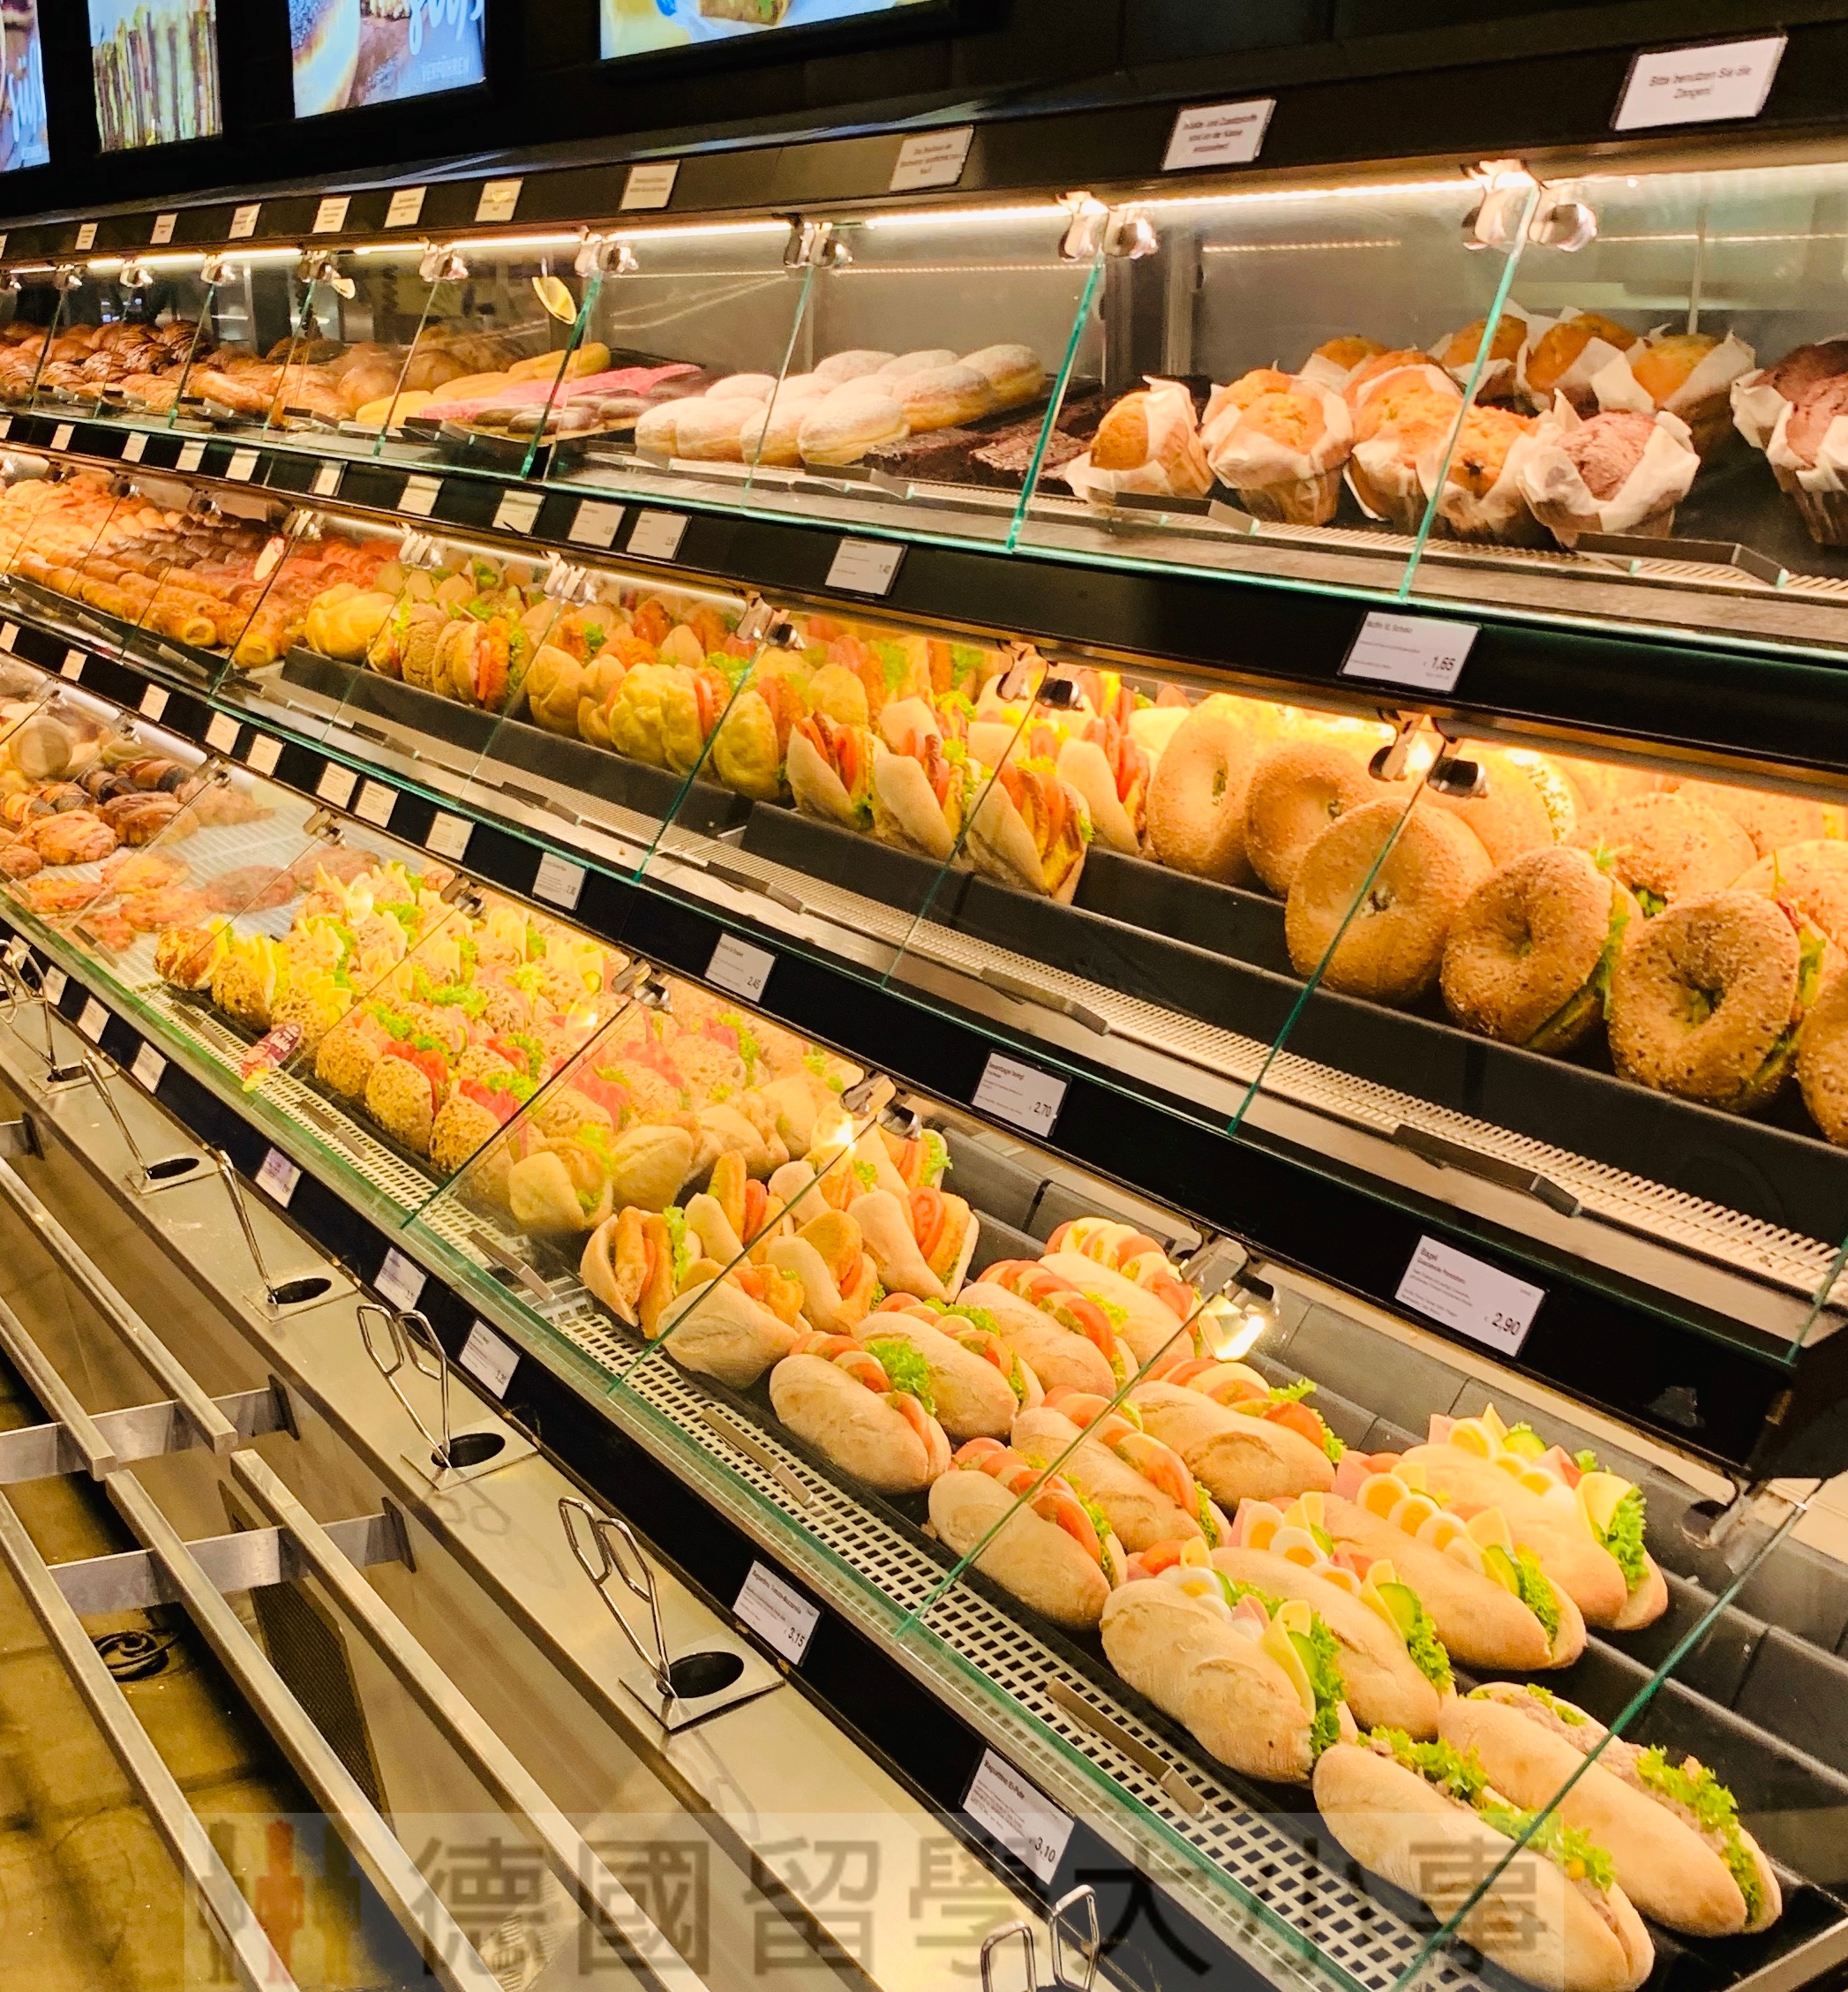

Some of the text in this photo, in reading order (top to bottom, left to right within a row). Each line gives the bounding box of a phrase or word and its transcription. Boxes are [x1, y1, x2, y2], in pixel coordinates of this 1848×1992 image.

[1717, 67, 1733, 79] Sie
[1032, 1100, 1053, 1120] 2,70
[1418, 1247, 1439, 1262] Bagel
[1489, 1311, 1523, 1340] 2,90
[785, 1625, 806, 1650] 3,15
[1032, 1834, 1057, 1867] 3,10
